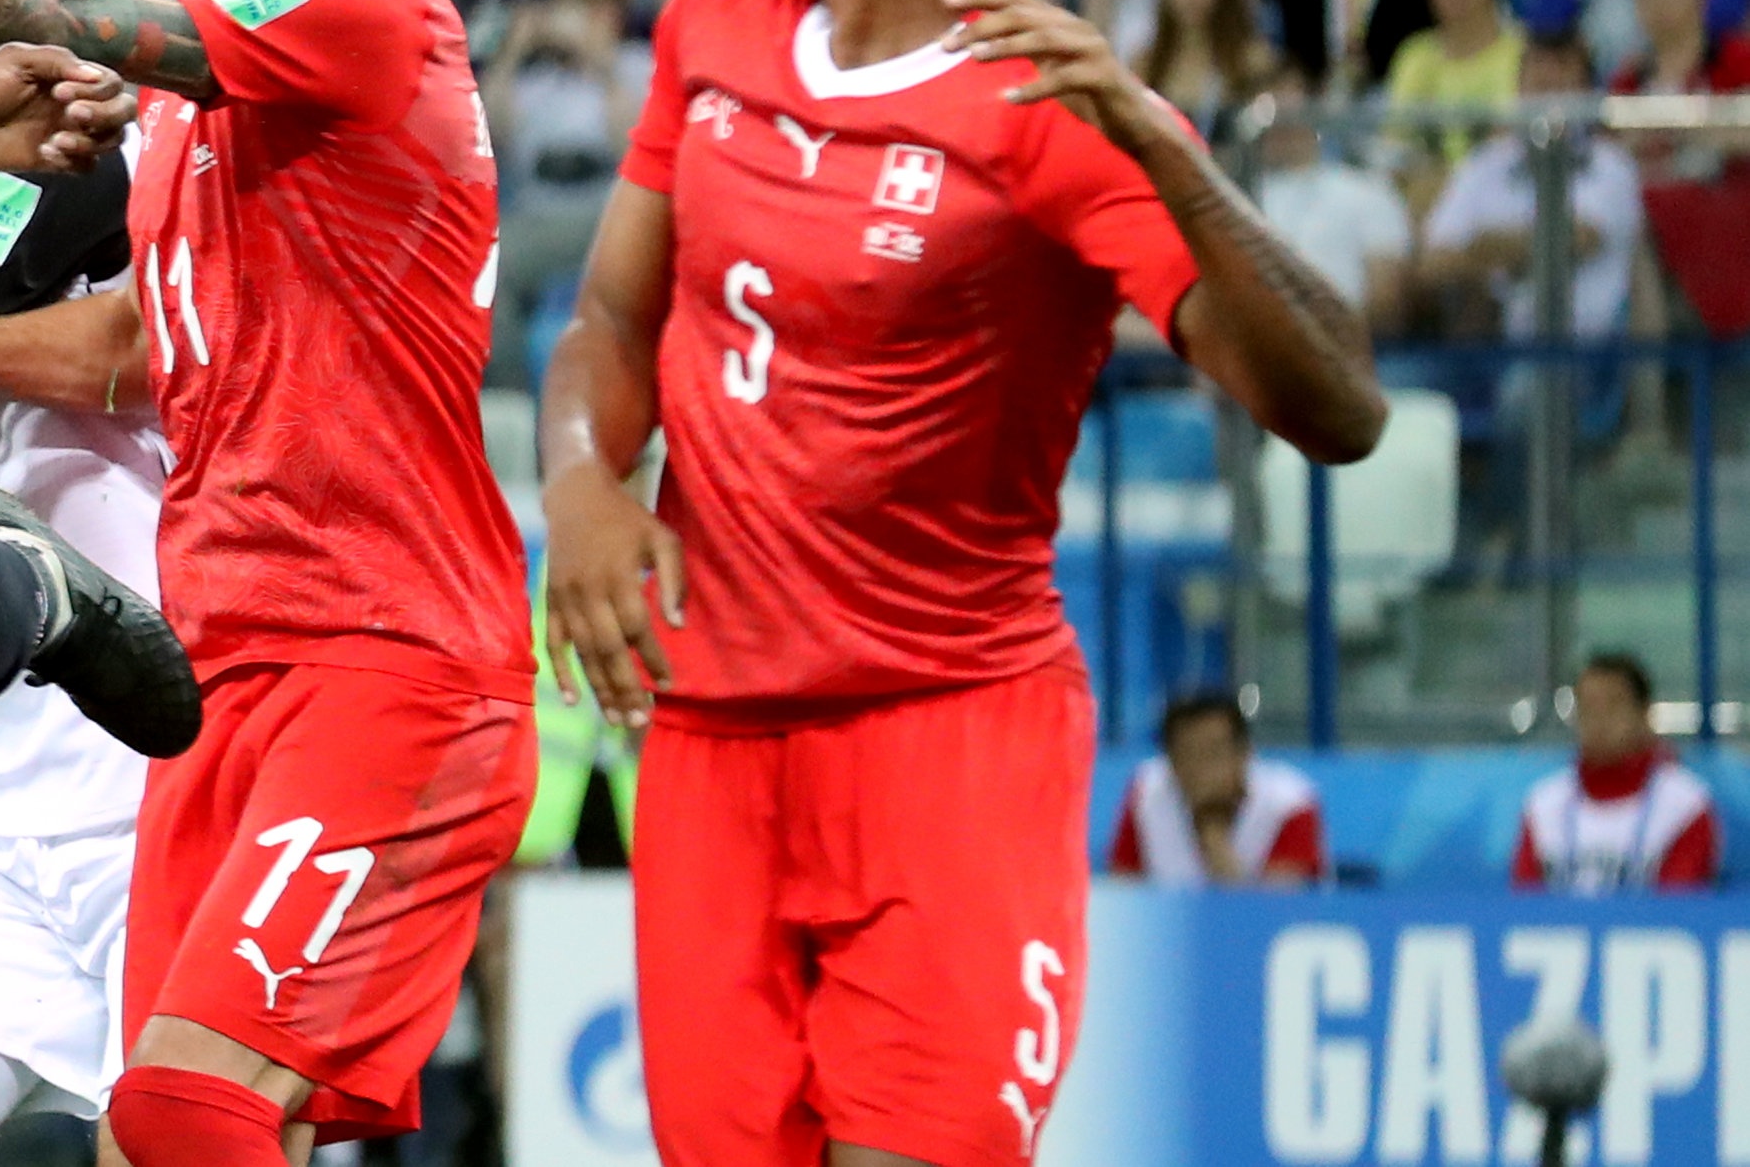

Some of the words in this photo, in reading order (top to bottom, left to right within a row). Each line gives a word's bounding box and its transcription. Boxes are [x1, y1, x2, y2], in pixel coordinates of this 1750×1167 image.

[146, 236, 211, 374] 11
[722, 260, 775, 405] 5
[241, 816, 376, 964] 11
[1014, 939, 1066, 1087] 5
[1262, 923, 1750, 1167] GAZP
